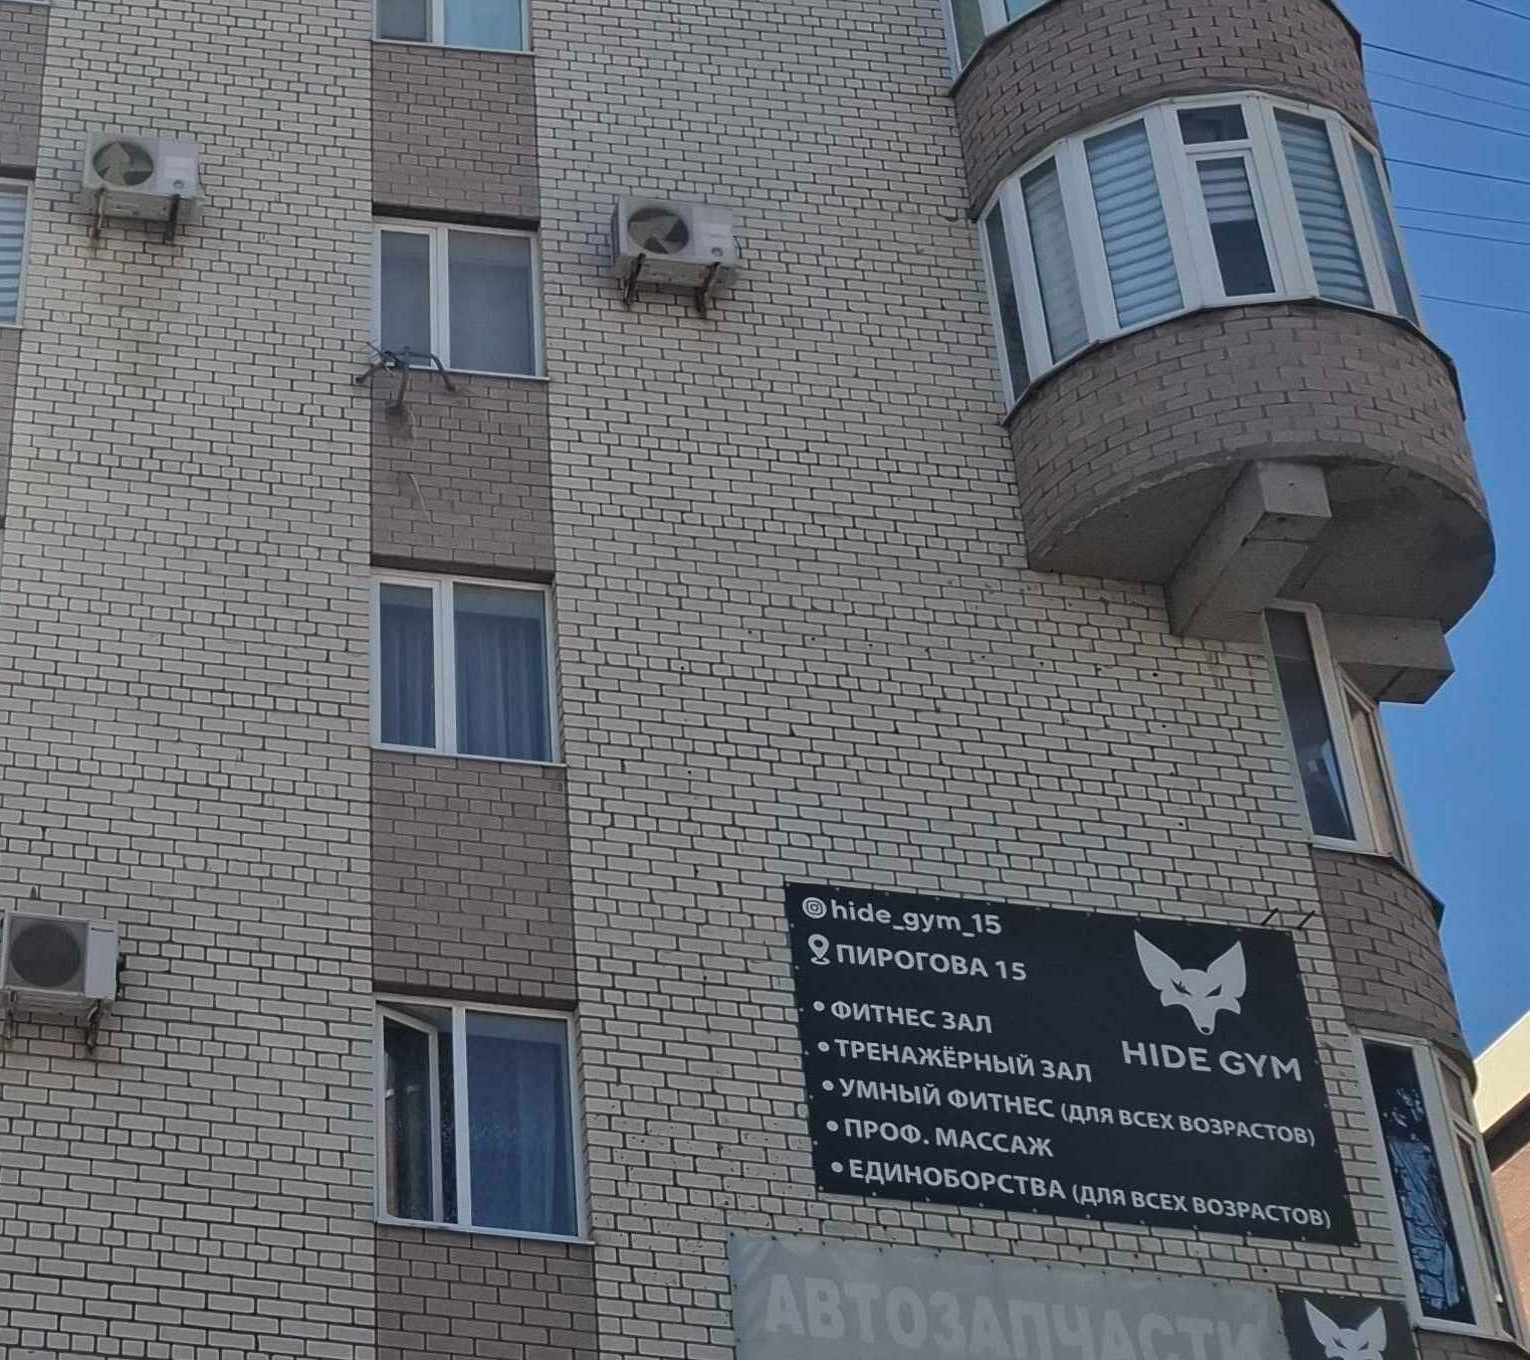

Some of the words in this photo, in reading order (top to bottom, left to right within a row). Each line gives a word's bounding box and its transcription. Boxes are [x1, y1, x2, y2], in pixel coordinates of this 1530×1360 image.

[831, 899, 1002, 938] hide_gym_15
[836, 943, 988, 978] ПИРОГОВА
[995, 960, 1027, 981] 15
[831, 1000, 937, 1029] ФИТНЕС
[941, 1011, 993, 1034] ЗАЛ
[834, 1038, 1036, 1077] ТРЕНАЖЁРНЫЙ
[1040, 1059, 1093, 1083] ЗАЛ
[1121, 1040, 1212, 1073] HIDE
[1219, 1050, 1303, 1082] GYM
[838, 1077, 942, 1107] УМНЫЙ
[947, 1089, 1055, 1119] ФИТНЕС
[1061, 1102, 1115, 1126] (ДЛЯ
[1119, 1109, 1175, 1131] ВСЕХ
[1178, 1114, 1316, 1148] ВОЗРАСТОВ)
[843, 1117, 931, 1145] ПРОФ.
[935, 1126, 1054, 1158] МАССАЖ
[848, 1158, 1067, 1200] ЕДИНОБОРСТВА
[1072, 1183, 1127, 1207] (ДЛЯ
[1131, 1191, 1188, 1213] ВСЕХ
[1192, 1195, 1332, 1230] ВОЗРАСТОВ)
